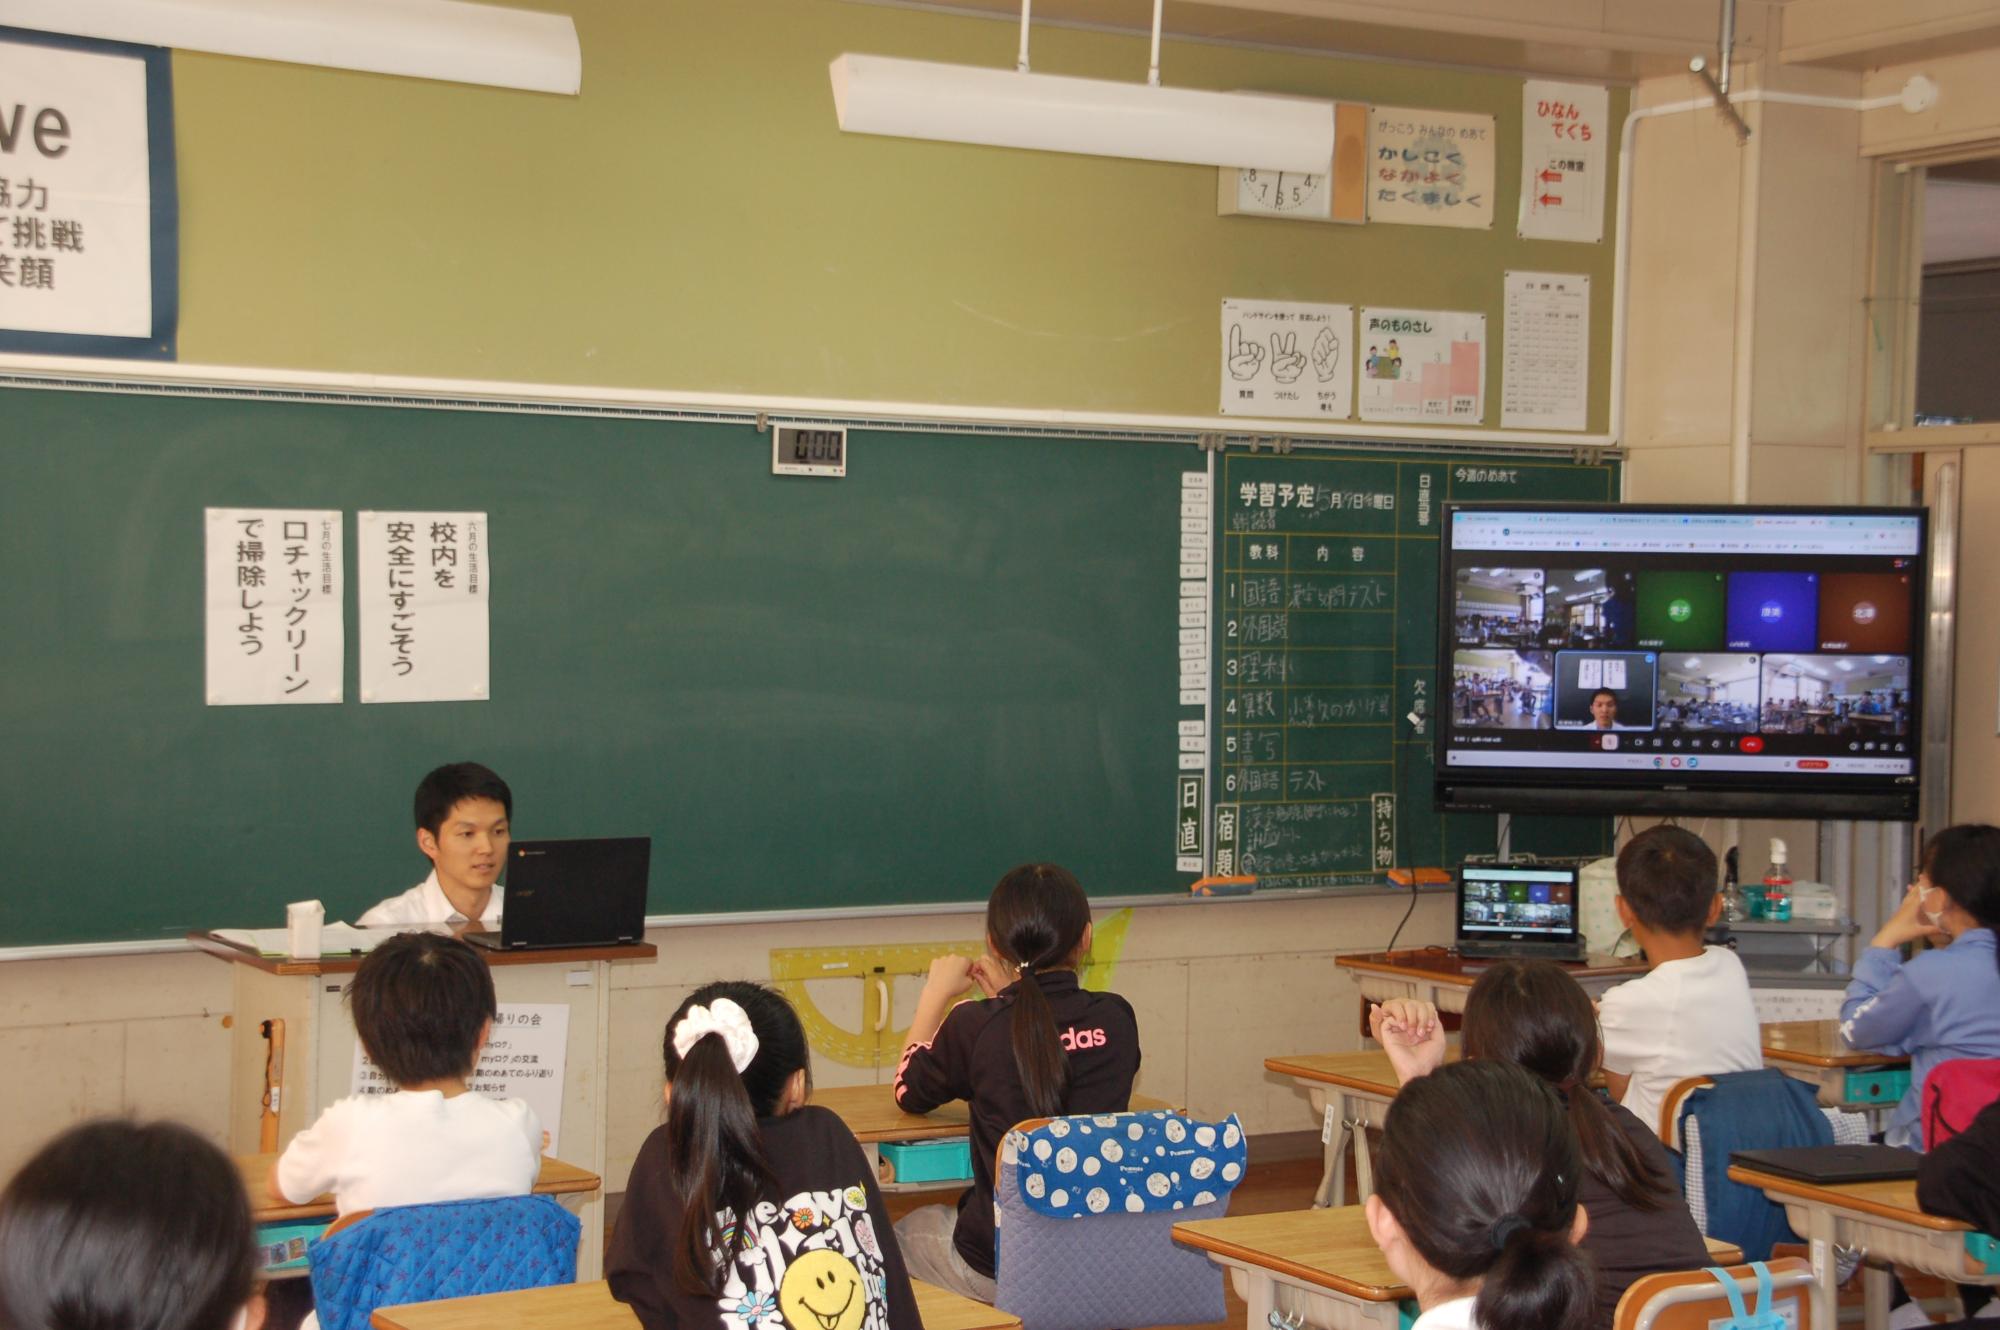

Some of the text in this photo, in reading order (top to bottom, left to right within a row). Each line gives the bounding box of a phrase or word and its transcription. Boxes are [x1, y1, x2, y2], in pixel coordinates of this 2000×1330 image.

[1537, 100, 1580, 120] ひなん
[1249, 168, 1257, 182] 8
[1304, 174, 1312, 187] 4
[1378, 168, 1462, 186] なかよく
[1260, 184, 1268, 198] 7
[1276, 191, 1284, 206] 6
[1293, 187, 1300, 202] 5
[0, 216, 85, 254] 挑戦
[1368, 317, 1433, 334] 声のものさし
[1455, 468, 1518, 484] 今週のめあて
[1240, 482, 1315, 508] 学習予定
[430, 521, 458, 589] 校内を
[1249, 544, 1279, 560] 教科
[237, 518, 266, 656] で掃除しよう
[1230, 583, 1235, 598] 1
[387, 521, 416, 677] 安全にすごそう
[1227, 620, 1238, 637] 2
[1226, 659, 1238, 676] 3
[1226, 699, 1238, 715] 4
[1226, 736, 1237, 753] 5
[1226, 774, 1237, 792] 6
[1180, 781, 1199, 851] 日直
[1376, 799, 1393, 866] 持ち物
[1215, 810, 1235, 878] 宿題
[1060, 1027, 1107, 1050] das
